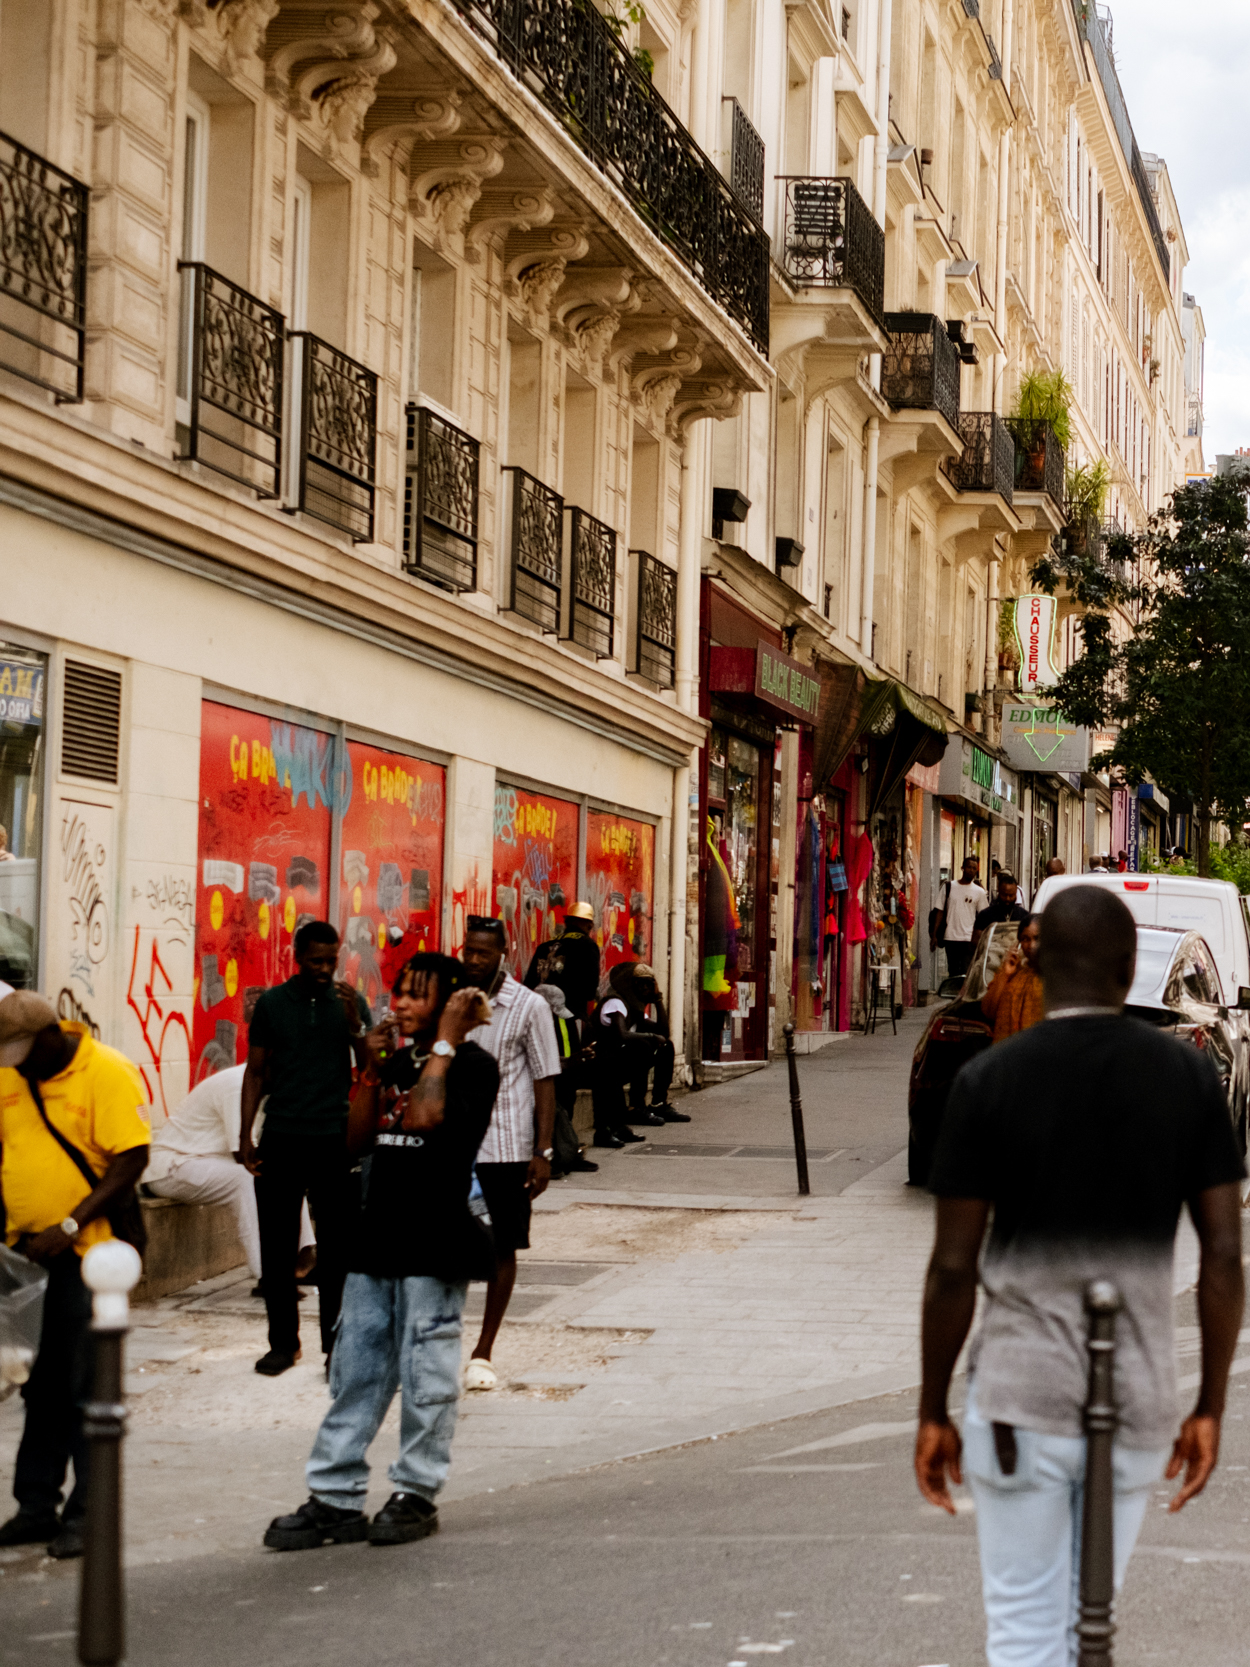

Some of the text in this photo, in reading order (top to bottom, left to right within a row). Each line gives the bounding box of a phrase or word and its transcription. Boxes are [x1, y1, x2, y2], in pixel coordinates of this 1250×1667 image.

[1028, 598, 1041, 682] CHAUSSEUR
[761, 653, 821, 717] BLACK BEAUTY
[230, 734, 248, 783] ÇA
[363, 761, 378, 804] ÇA
